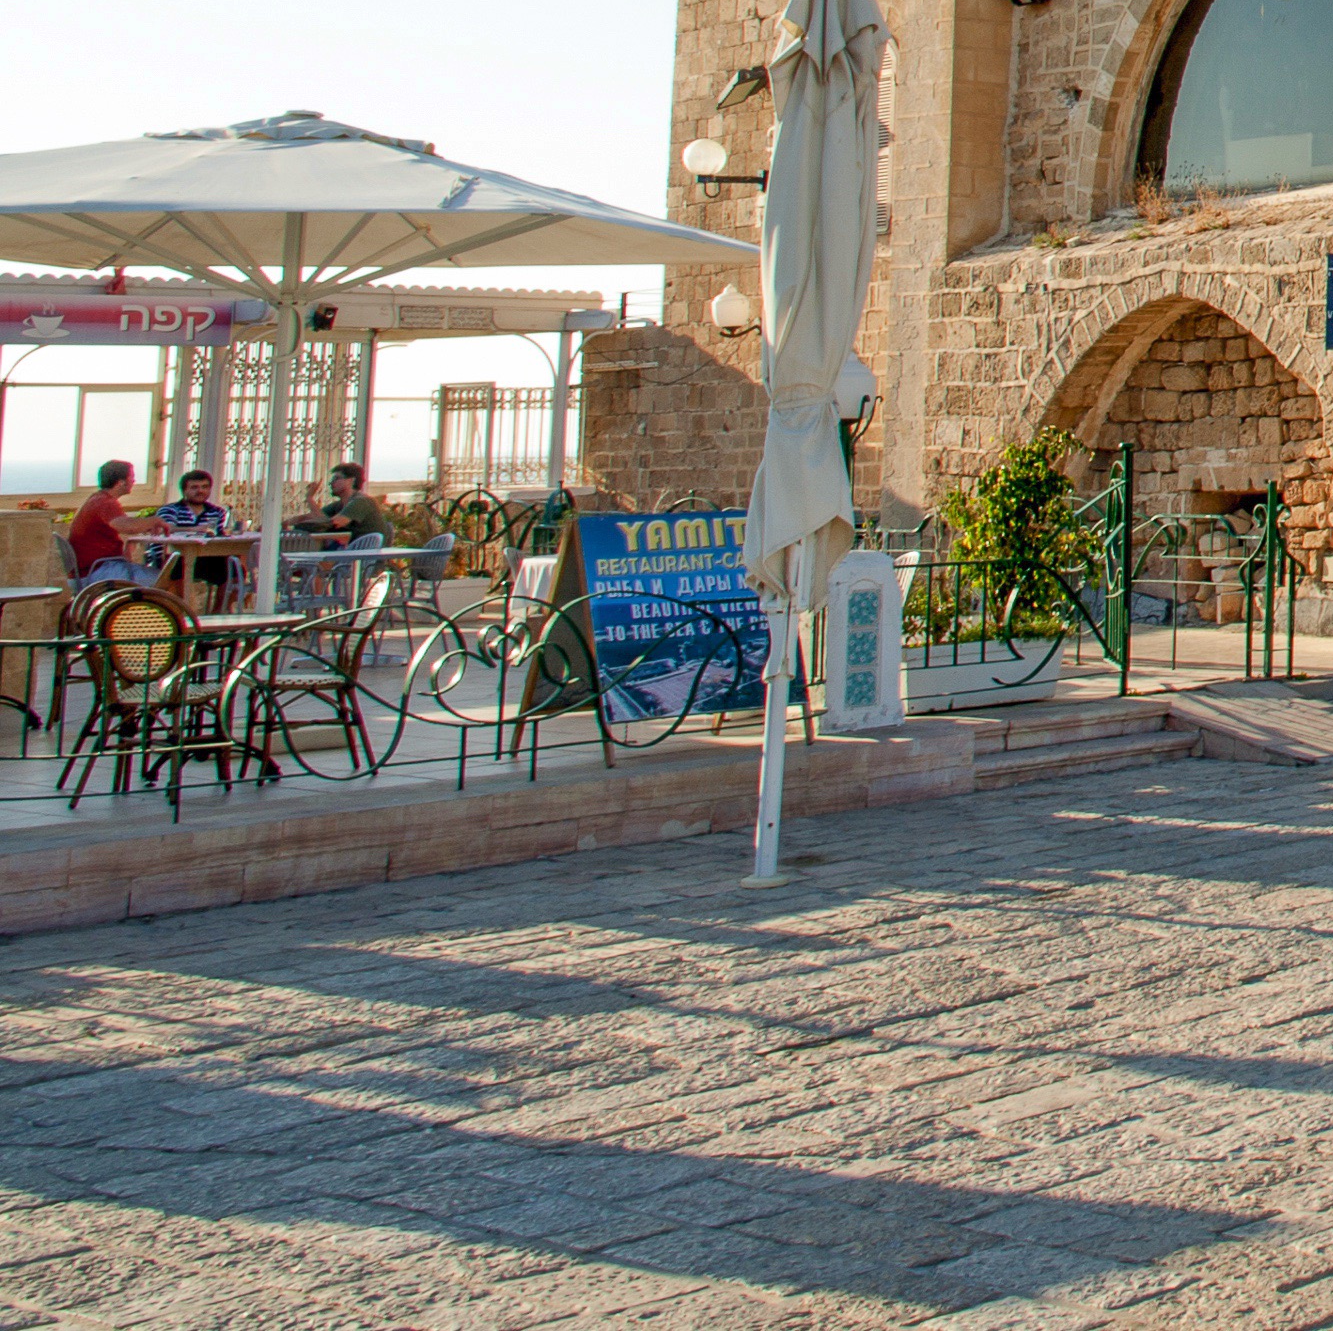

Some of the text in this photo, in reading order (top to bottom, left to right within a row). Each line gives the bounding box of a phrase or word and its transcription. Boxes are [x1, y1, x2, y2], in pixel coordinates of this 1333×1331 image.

[119, 304, 216, 341] קפה
[616, 518, 747, 553] YAMIT
[596, 552, 746, 576] RESTAURANT-CA
[678, 574, 731, 597] ДАРЫ
[605, 626, 627, 642] TO
[631, 622, 661, 640] THE
